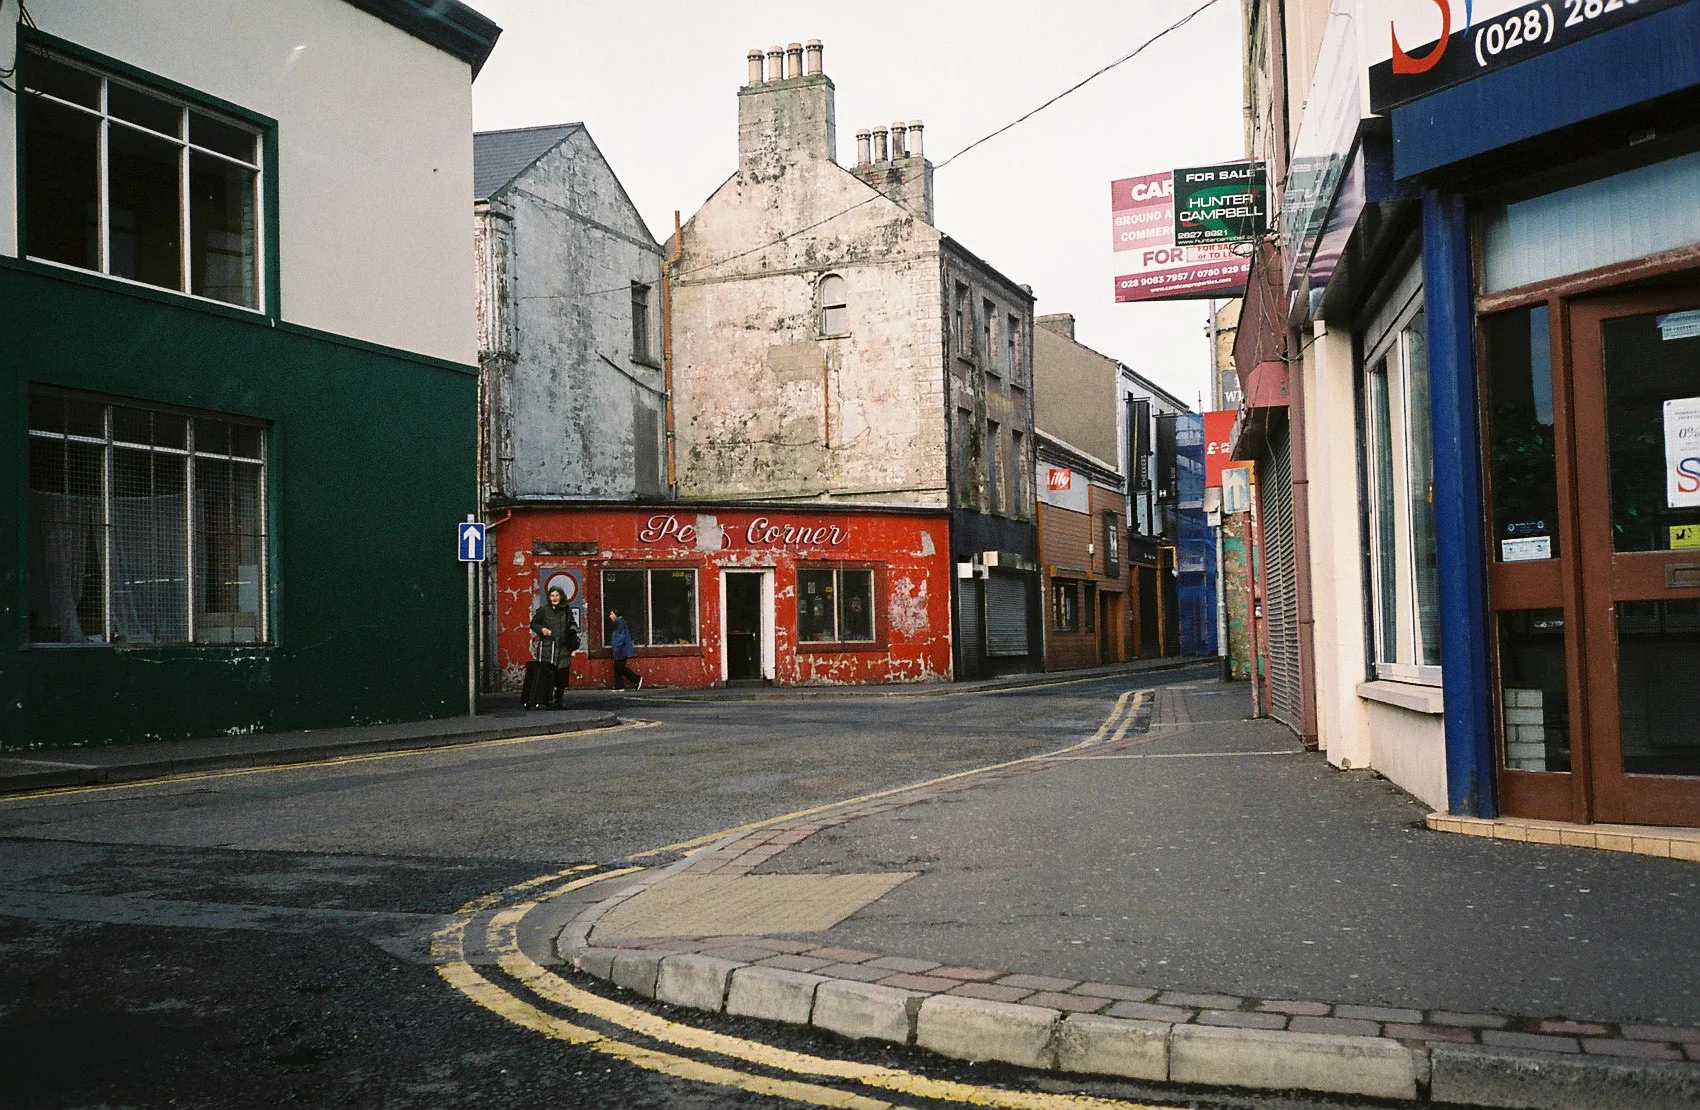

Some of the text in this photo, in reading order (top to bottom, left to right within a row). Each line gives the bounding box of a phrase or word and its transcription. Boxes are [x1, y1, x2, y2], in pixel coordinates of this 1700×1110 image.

[1475, 4, 1554, 67] (028)
[1186, 169, 1255, 182] FOR SALE
[1189, 193, 1253, 208] HUNTER
[1115, 210, 1161, 226] GROUND
[1180, 206, 1263, 221] CAMPBELL
[1143, 247, 1183, 266] FOR
[1121, 280, 1139, 288] 028
[1050, 471, 1070, 488] illy
[746, 517, 848, 545] Corner
